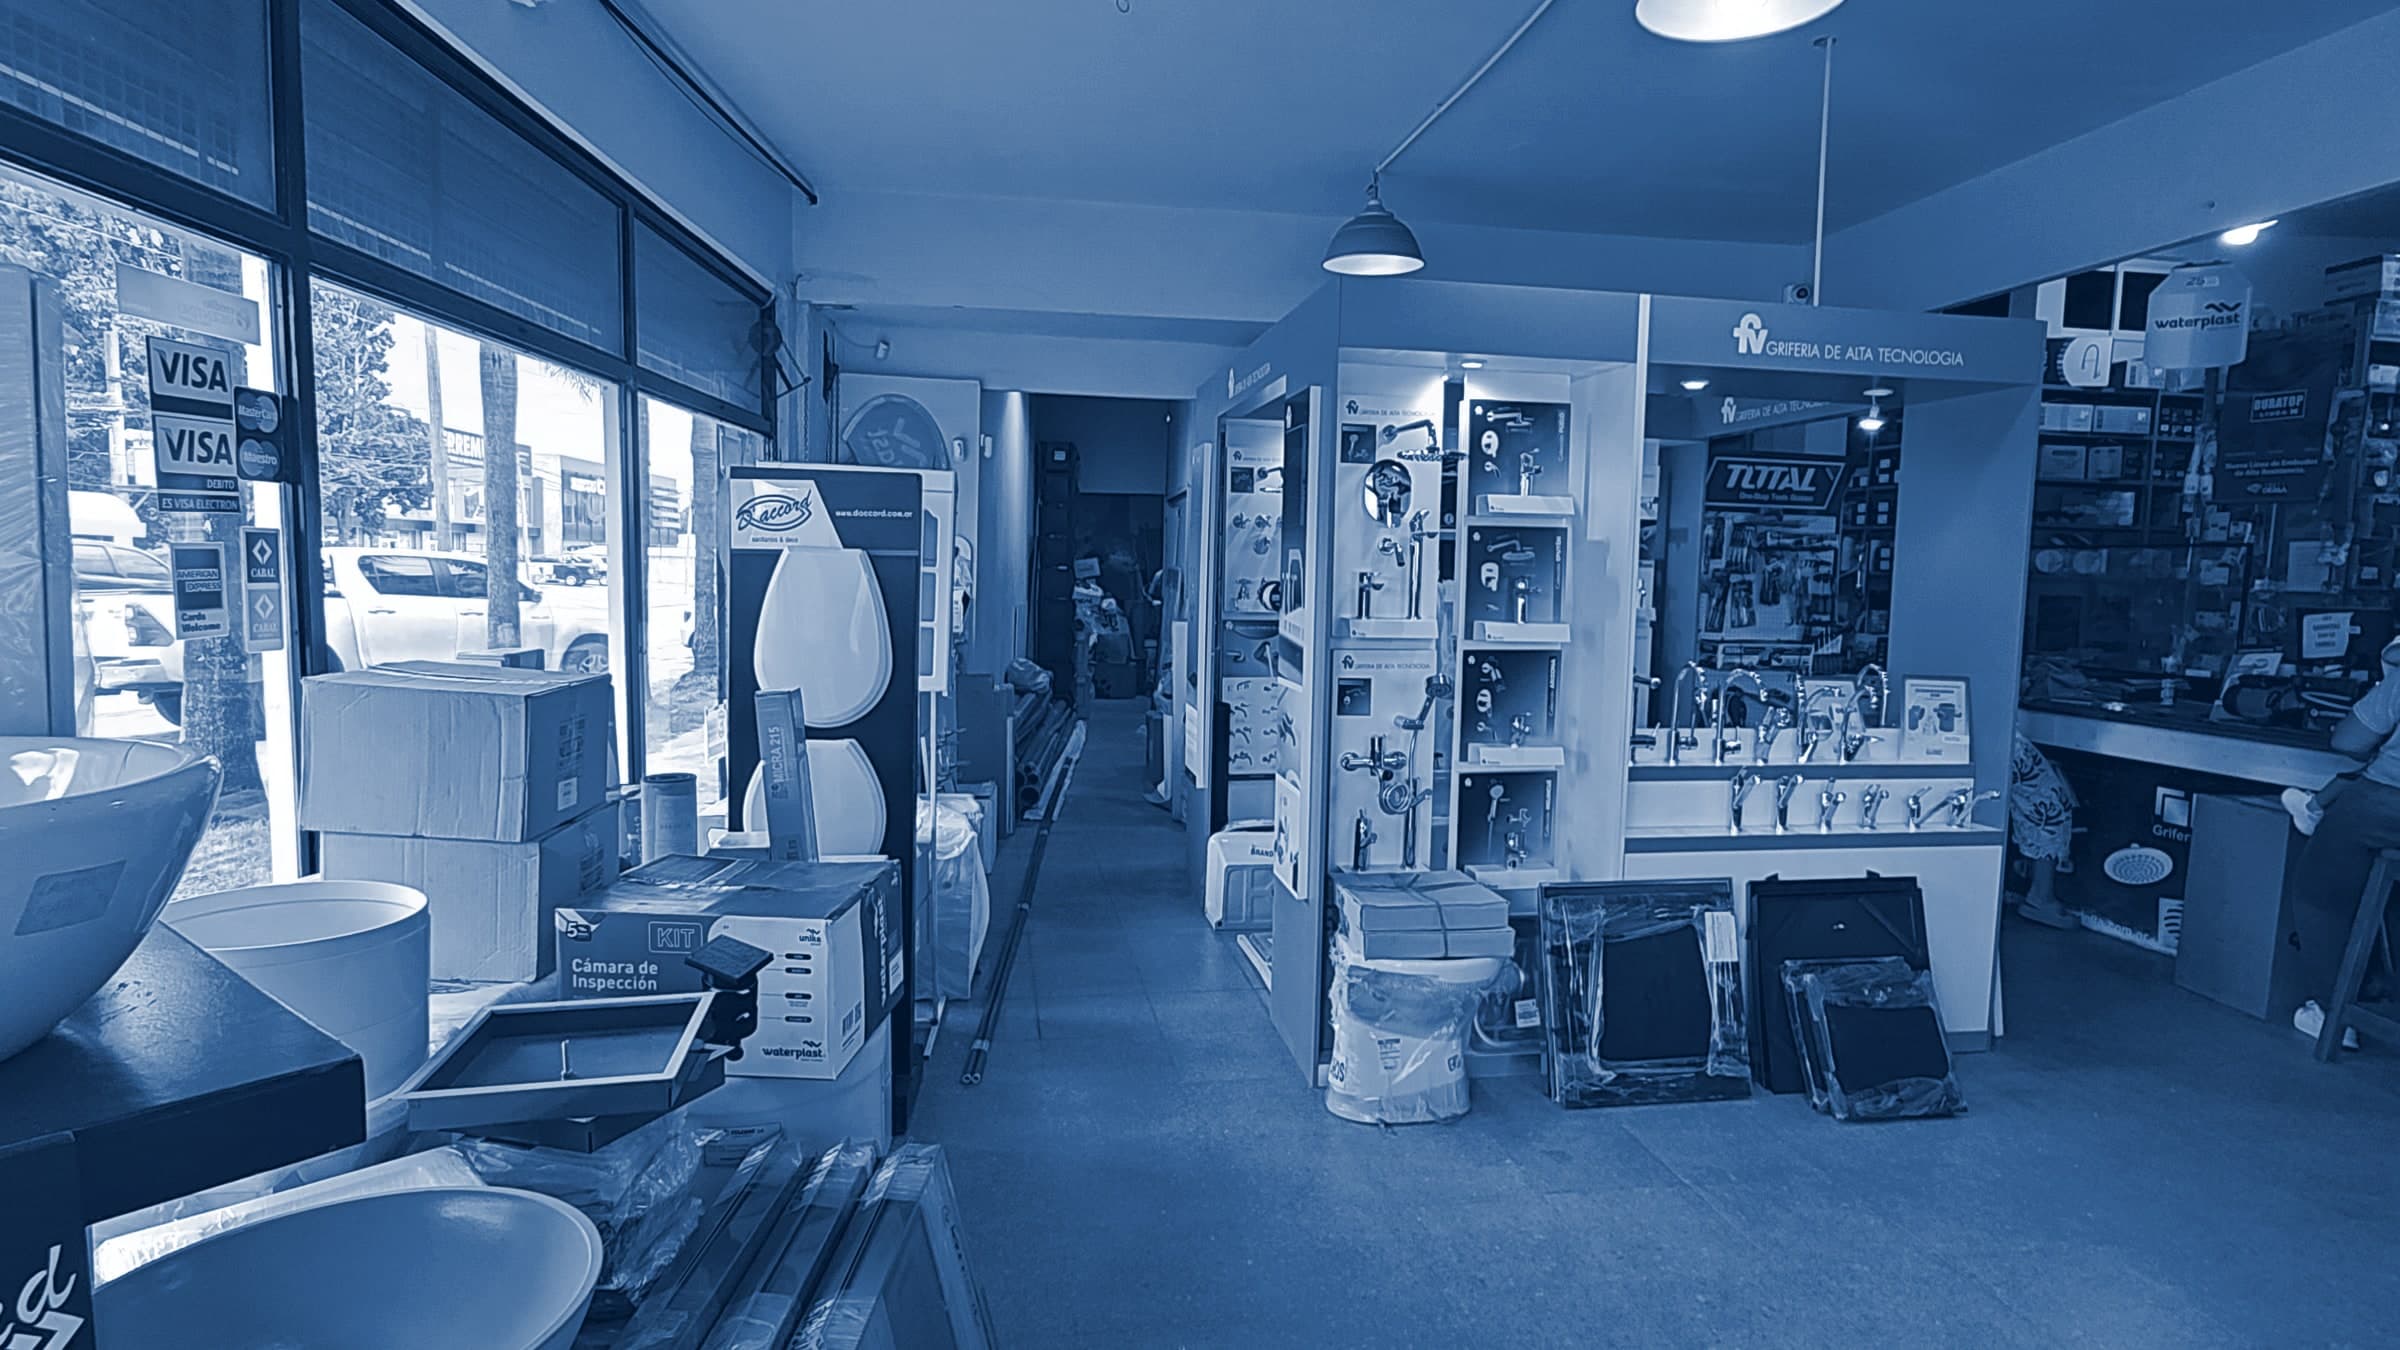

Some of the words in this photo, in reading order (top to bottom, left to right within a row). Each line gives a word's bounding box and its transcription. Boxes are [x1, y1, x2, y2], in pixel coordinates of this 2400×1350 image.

[2154, 313, 2240, 331] waterplast
[1766, 340, 1820, 359] GRIFERIA
[1824, 344, 1841, 360] DE
[1844, 346, 1873, 361] ALTA
[1877, 347, 1964, 366] TECNOLOGIA
[154, 349, 228, 393] VISA
[162, 428, 233, 465] VISA
[1726, 464, 1816, 491] TOTAL
[162, 498, 173, 508] ES
[175, 498, 195, 509] VISA
[196, 498, 238, 510] ELECTRON
[176, 569, 218, 579] AMERICAN
[250, 567, 277, 578] CABAL
[187, 581, 222, 592] EXPRESS
[181, 611, 207, 621] Cards
[181, 622, 222, 633] Welcome
[252, 623, 279, 633] CABAL
[768, 726, 782, 746] 215
[770, 747, 785, 783] MICRA
[657, 927, 696, 949] KIT
[572, 957, 634, 974] Cámara
[638, 960, 658, 975] de
[572, 974, 658, 992] Inspección
[762, 1047, 823, 1060] waterplast
